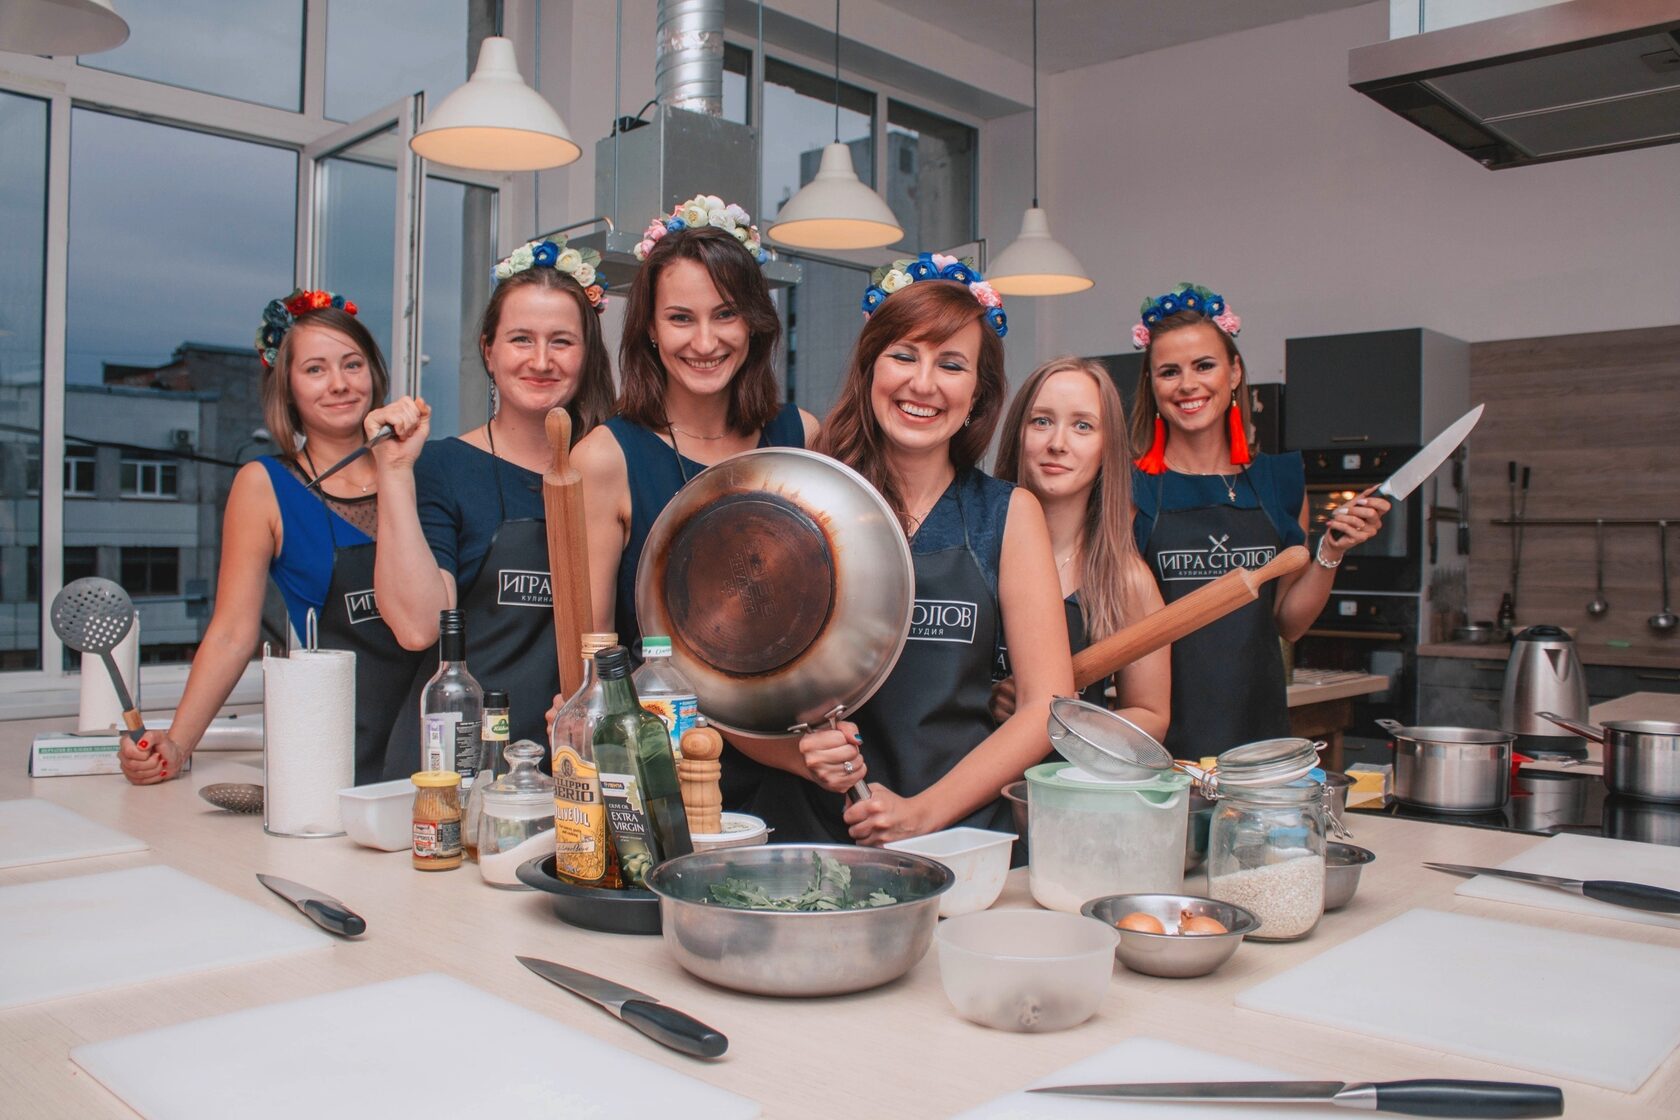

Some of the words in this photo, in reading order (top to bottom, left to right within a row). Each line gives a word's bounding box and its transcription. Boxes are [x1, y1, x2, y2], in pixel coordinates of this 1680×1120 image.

[1162, 553, 1205, 570] ИГРА
[1208, 550, 1274, 569] СТОЛОВ
[503, 574, 551, 595] ИГРА
[611, 811, 639, 823] EXTRA
[612, 821, 645, 833] VIRGIN
